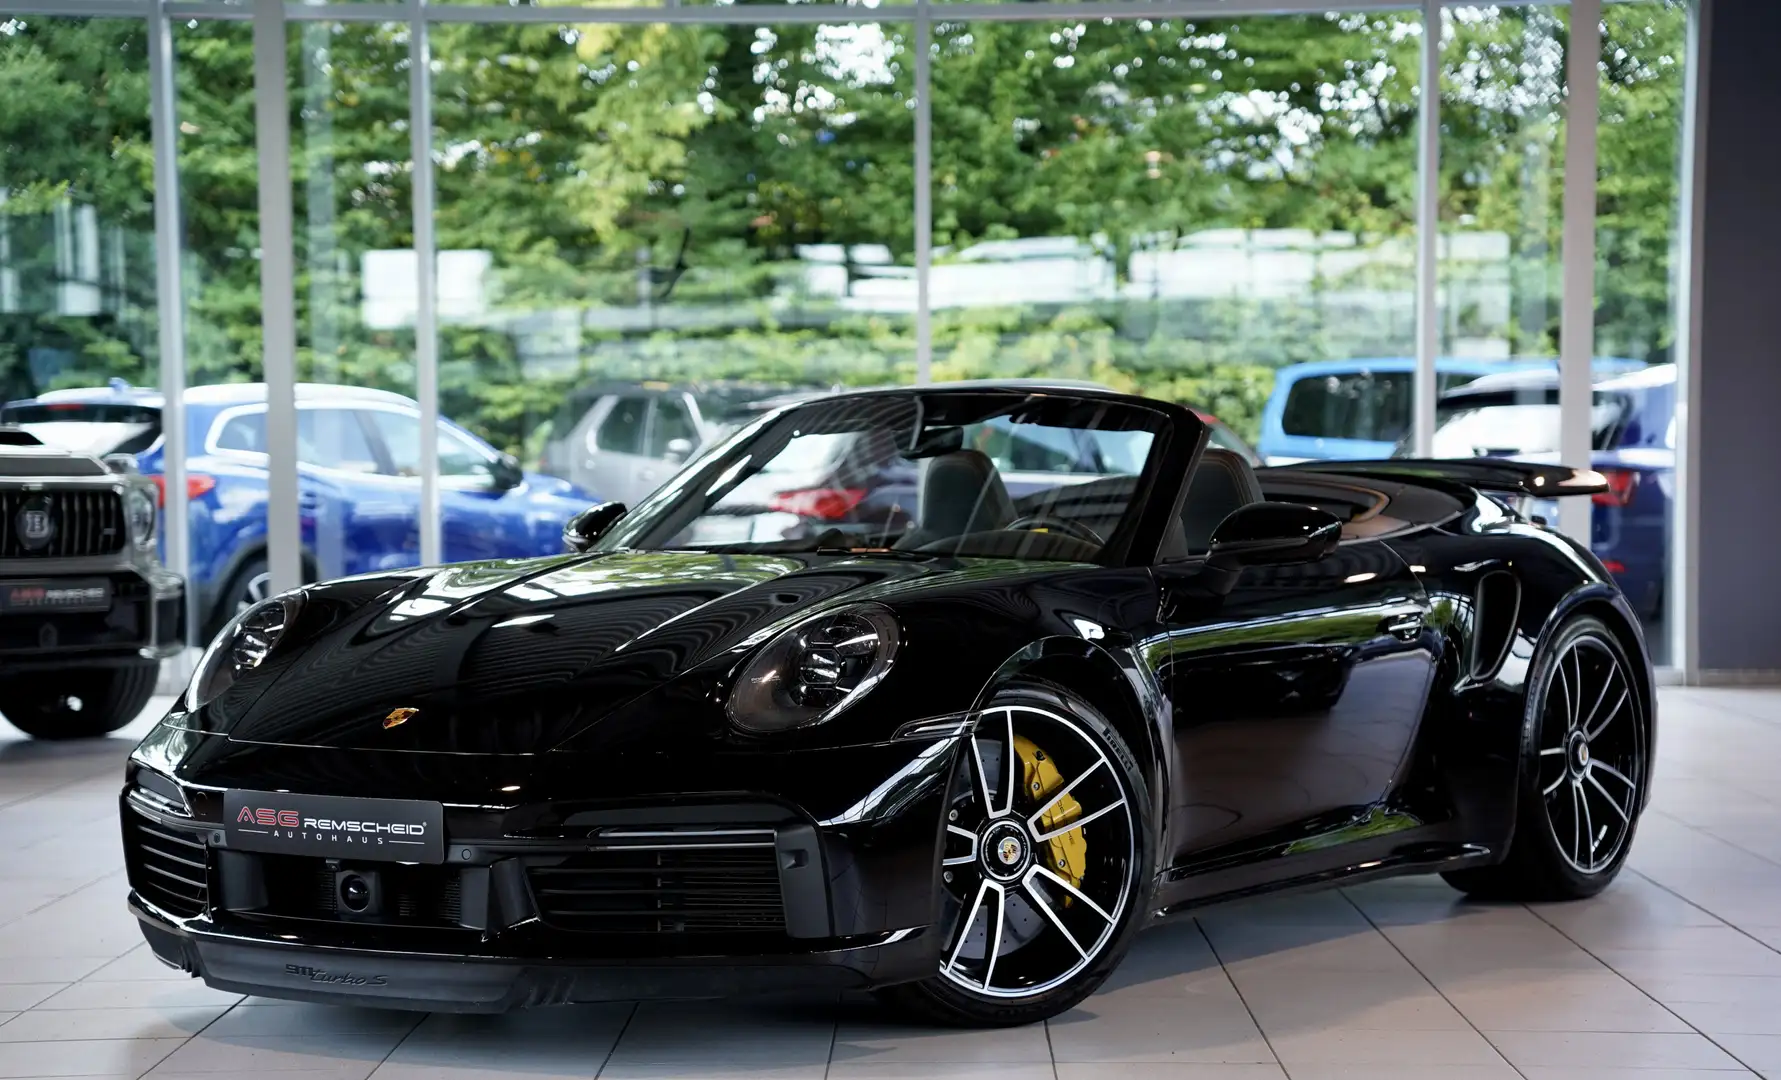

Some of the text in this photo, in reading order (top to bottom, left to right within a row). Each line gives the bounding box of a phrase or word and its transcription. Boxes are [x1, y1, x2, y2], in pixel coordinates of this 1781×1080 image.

[1102, 727, 1133, 771] PIRELLI
[237, 806, 300, 828] ASG
[274, 830, 383, 845] AUTOHAUS
[285, 963, 314, 977] 911
[367, 974, 389, 987] S
